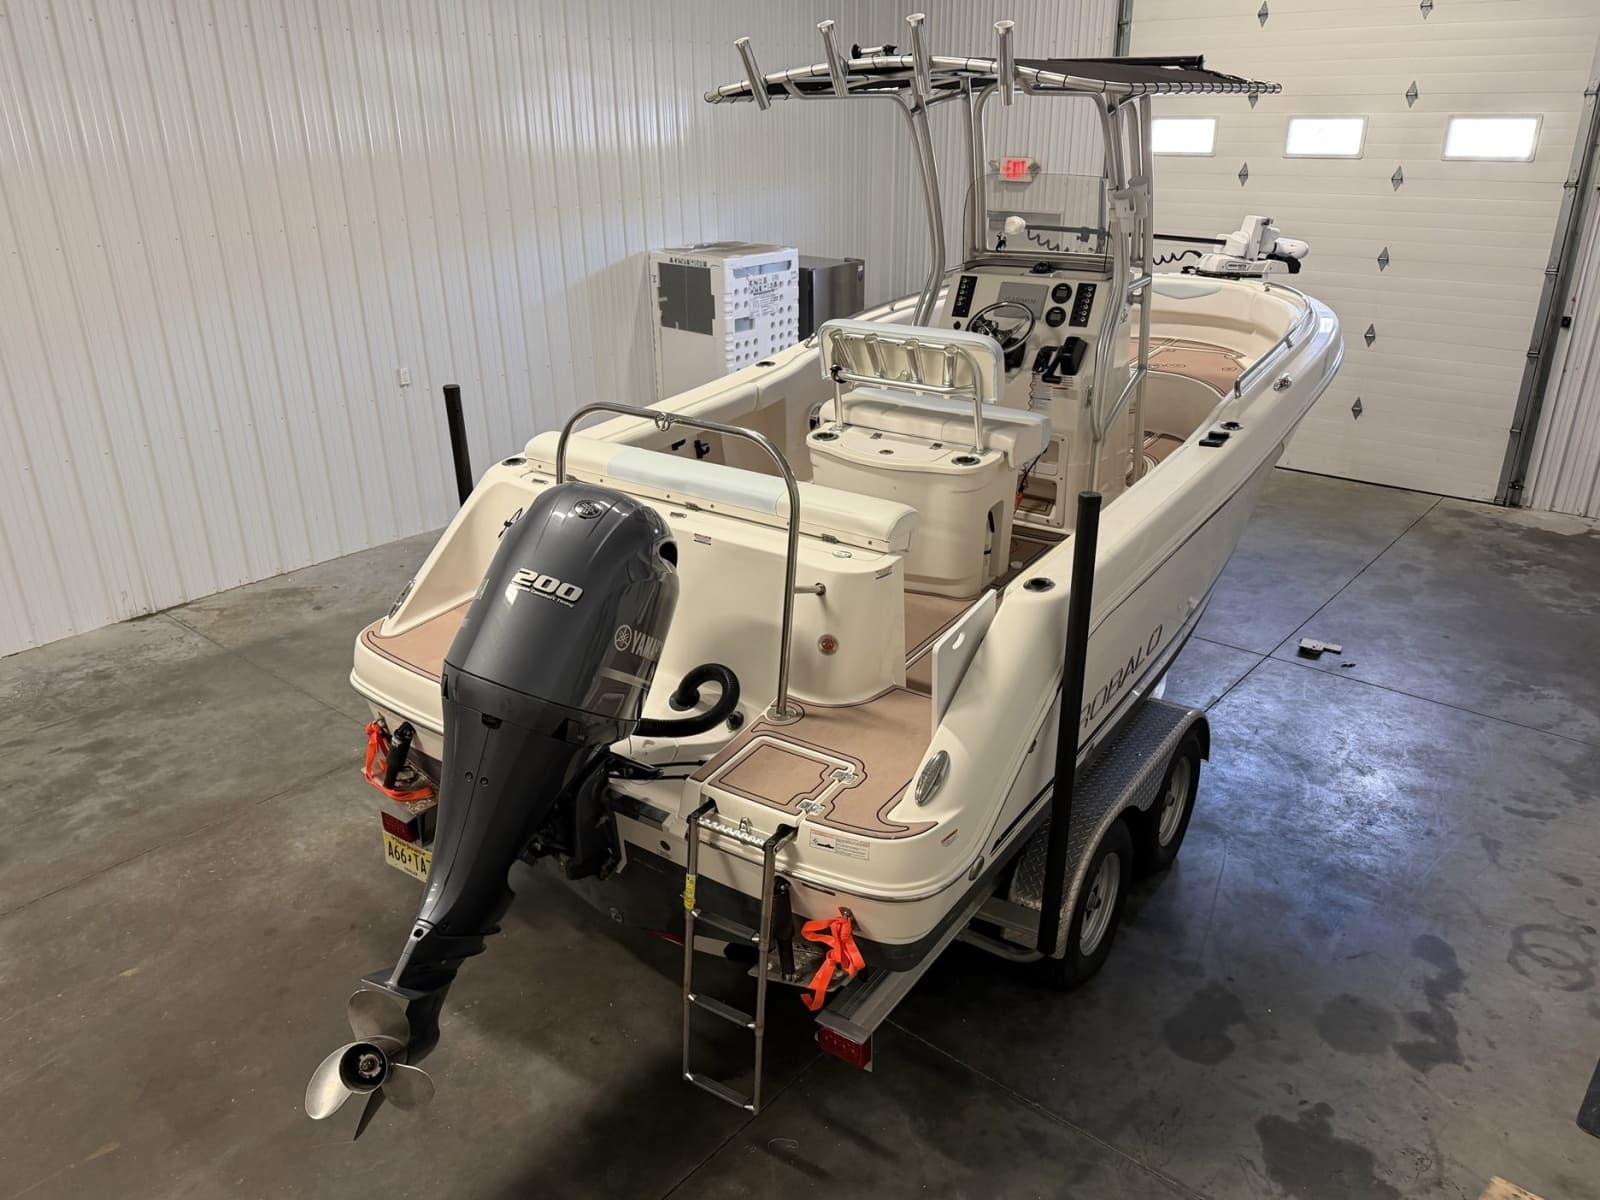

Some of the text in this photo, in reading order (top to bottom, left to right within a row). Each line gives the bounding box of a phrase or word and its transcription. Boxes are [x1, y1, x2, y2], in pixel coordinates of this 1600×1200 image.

[511, 567, 584, 602] 200
[631, 630, 664, 660] YAMA
[412, 853, 431, 875] TA
